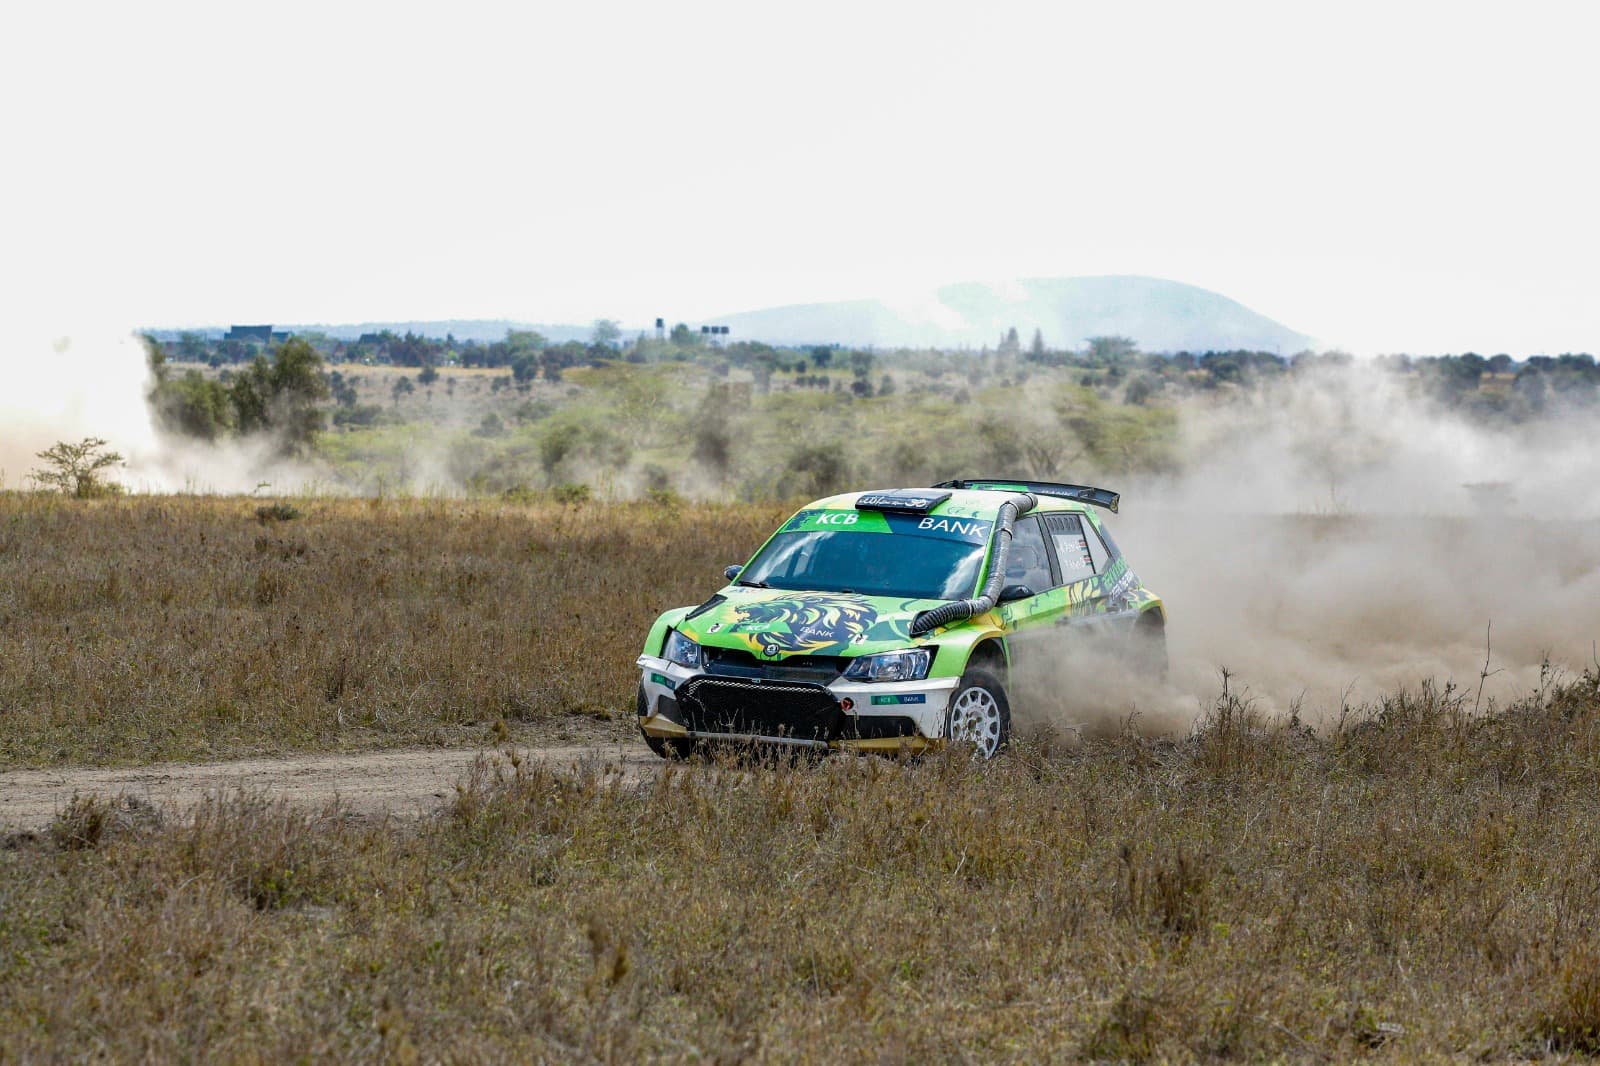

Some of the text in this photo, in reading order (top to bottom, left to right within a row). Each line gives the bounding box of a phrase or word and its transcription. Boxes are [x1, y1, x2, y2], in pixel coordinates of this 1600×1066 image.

[815, 513, 988, 538] KCB BANK
[799, 626, 836, 638] BANK
